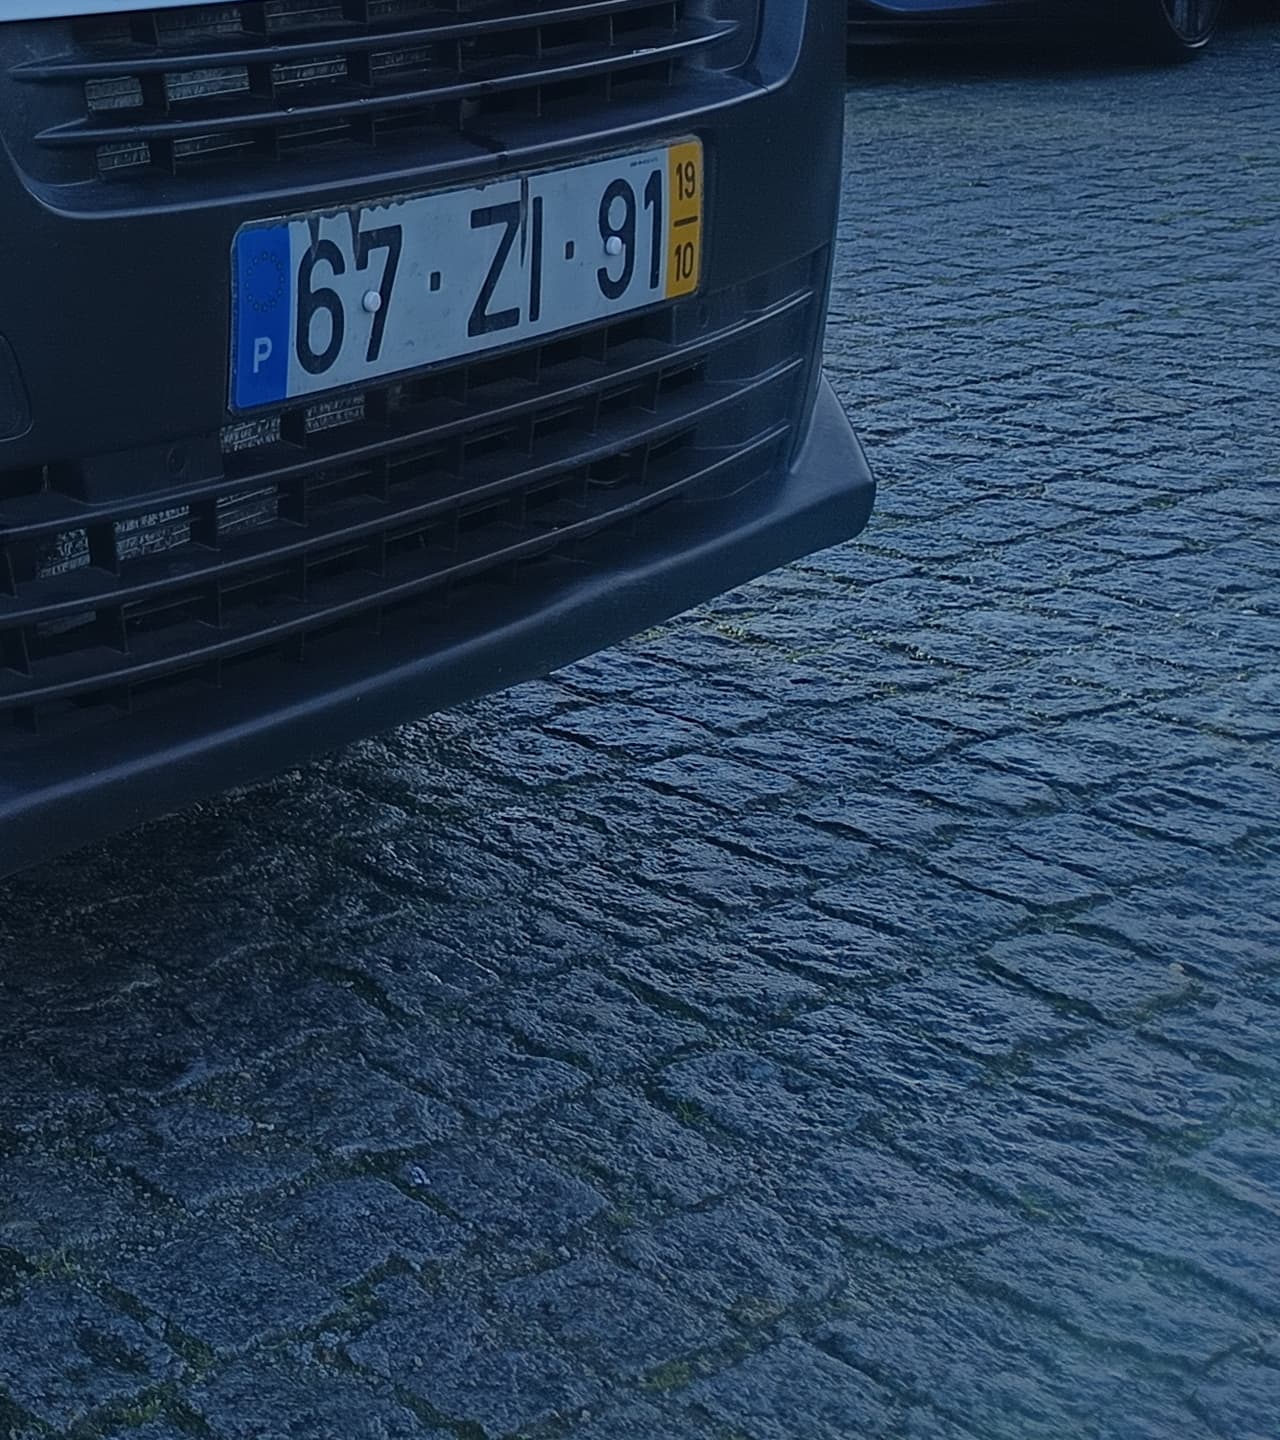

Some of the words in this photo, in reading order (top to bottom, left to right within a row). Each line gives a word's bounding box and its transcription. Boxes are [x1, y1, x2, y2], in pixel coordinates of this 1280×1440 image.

[675, 162, 697, 201] 19
[673, 242, 695, 282] 10
[252, 336, 273, 374] P
